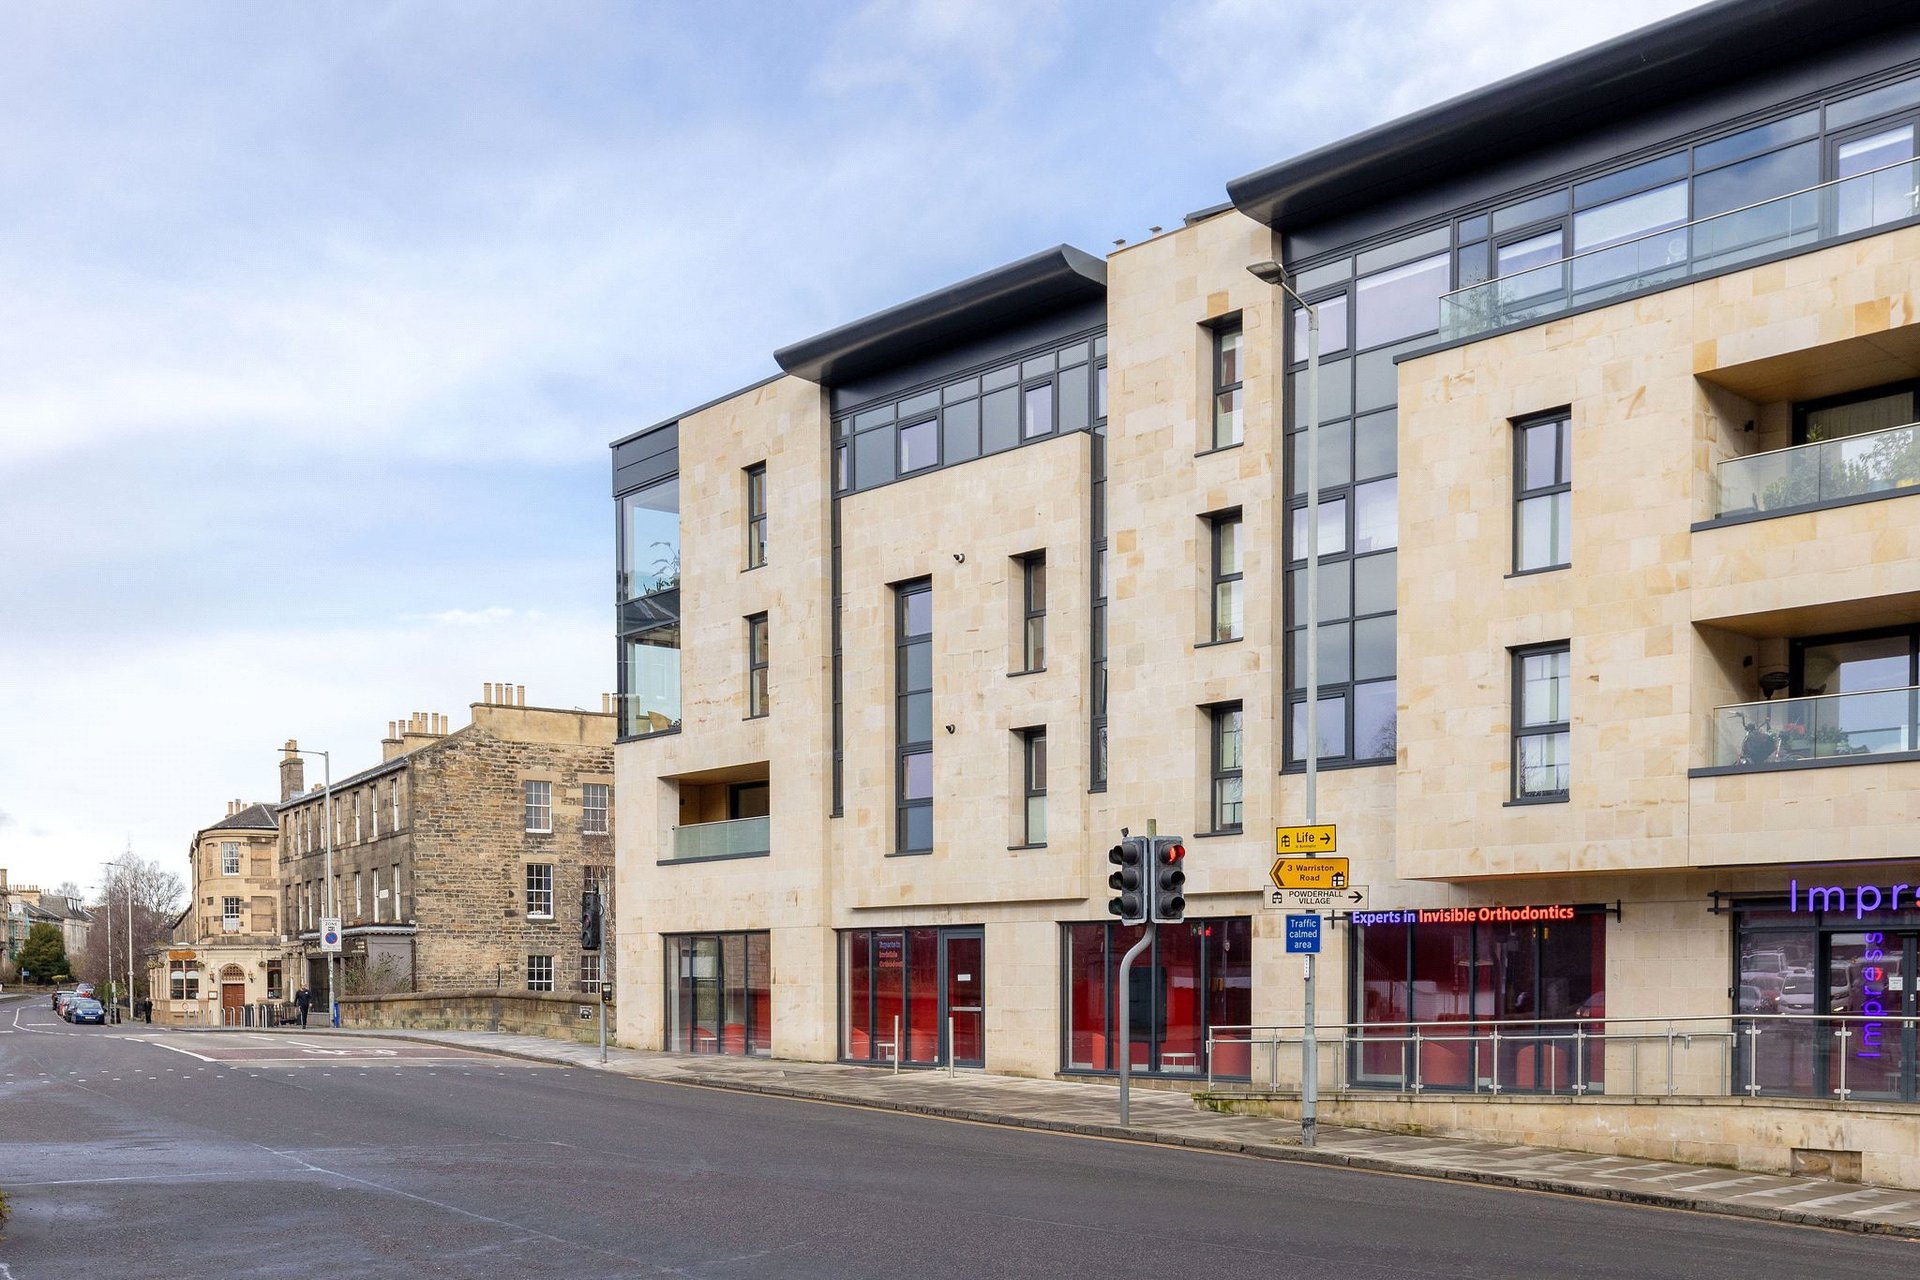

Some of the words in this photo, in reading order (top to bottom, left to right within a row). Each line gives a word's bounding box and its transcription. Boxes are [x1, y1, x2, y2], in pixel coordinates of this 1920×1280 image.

[1296, 832, 1315, 843] Life
[1299, 874, 1320, 882] Road
[1289, 890, 1343, 898] POWDERHALL
[1791, 879, 1920, 920] Impr
[1352, 911, 1400, 926] Experts
[1403, 909, 1416, 923] in
[1419, 907, 1476, 923] Invisible
[1479, 905, 1574, 921] Orthodontics
[1290, 919, 1317, 928] Traffic
[1289, 930, 1318, 938] calmed
[1294, 941, 1312, 949] area
[1857, 931, 1888, 1059] Impress
